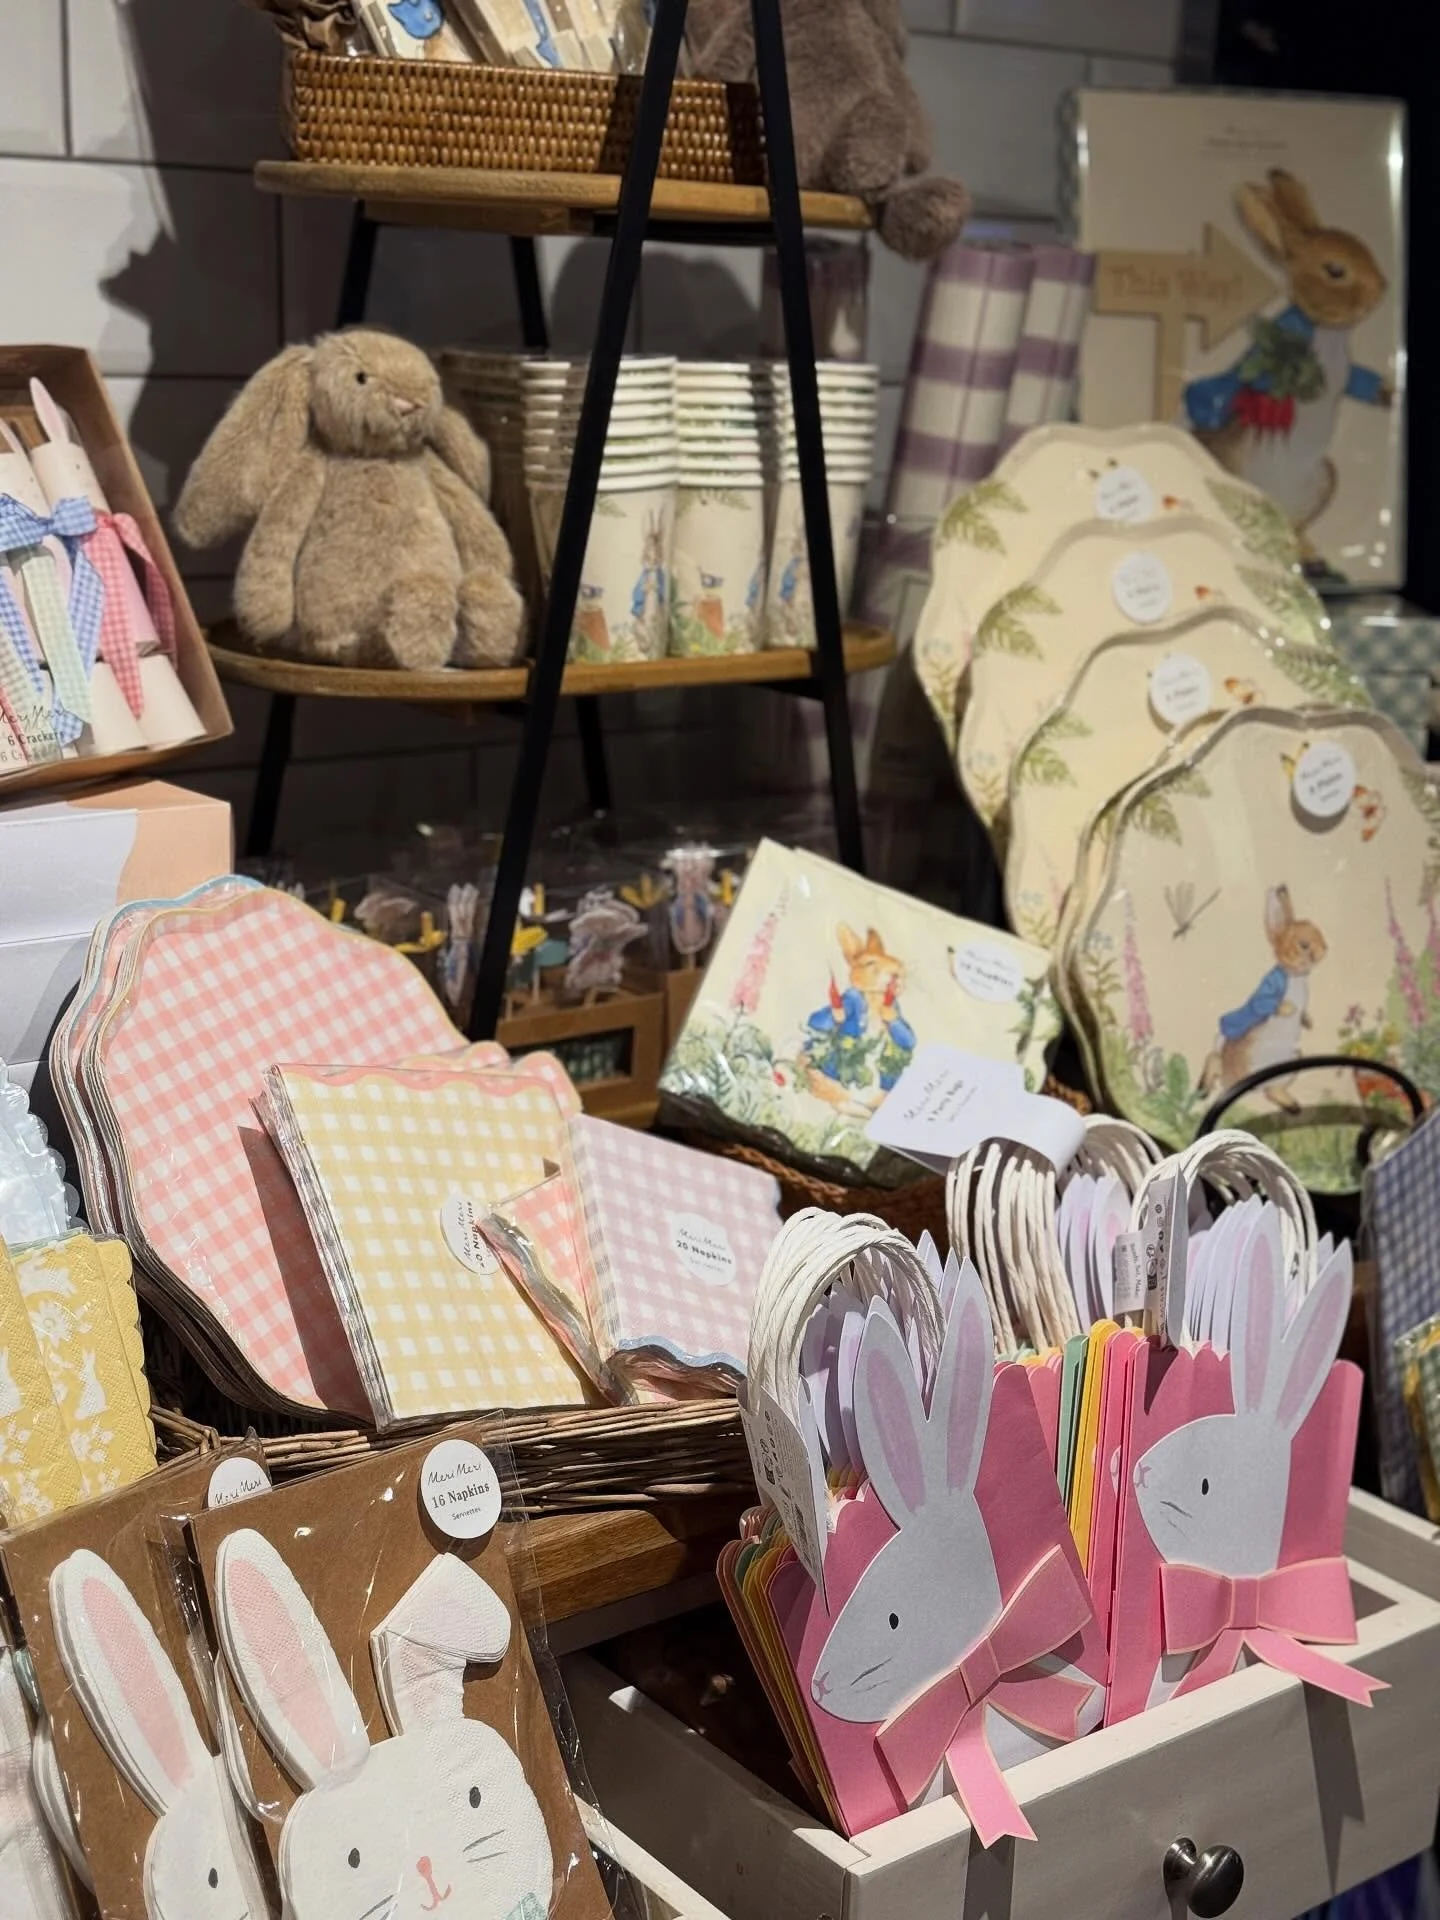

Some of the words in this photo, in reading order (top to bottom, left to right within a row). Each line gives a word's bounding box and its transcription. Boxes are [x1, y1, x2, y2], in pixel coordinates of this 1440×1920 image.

[7, 735, 16, 746] 6
[240, 1476, 262, 1493] Meri
[428, 1470, 456, 1487] Meri
[456, 1463, 482, 1479] Meri
[432, 1494, 446, 1509] 16
[447, 1482, 490, 1504] Napkins
